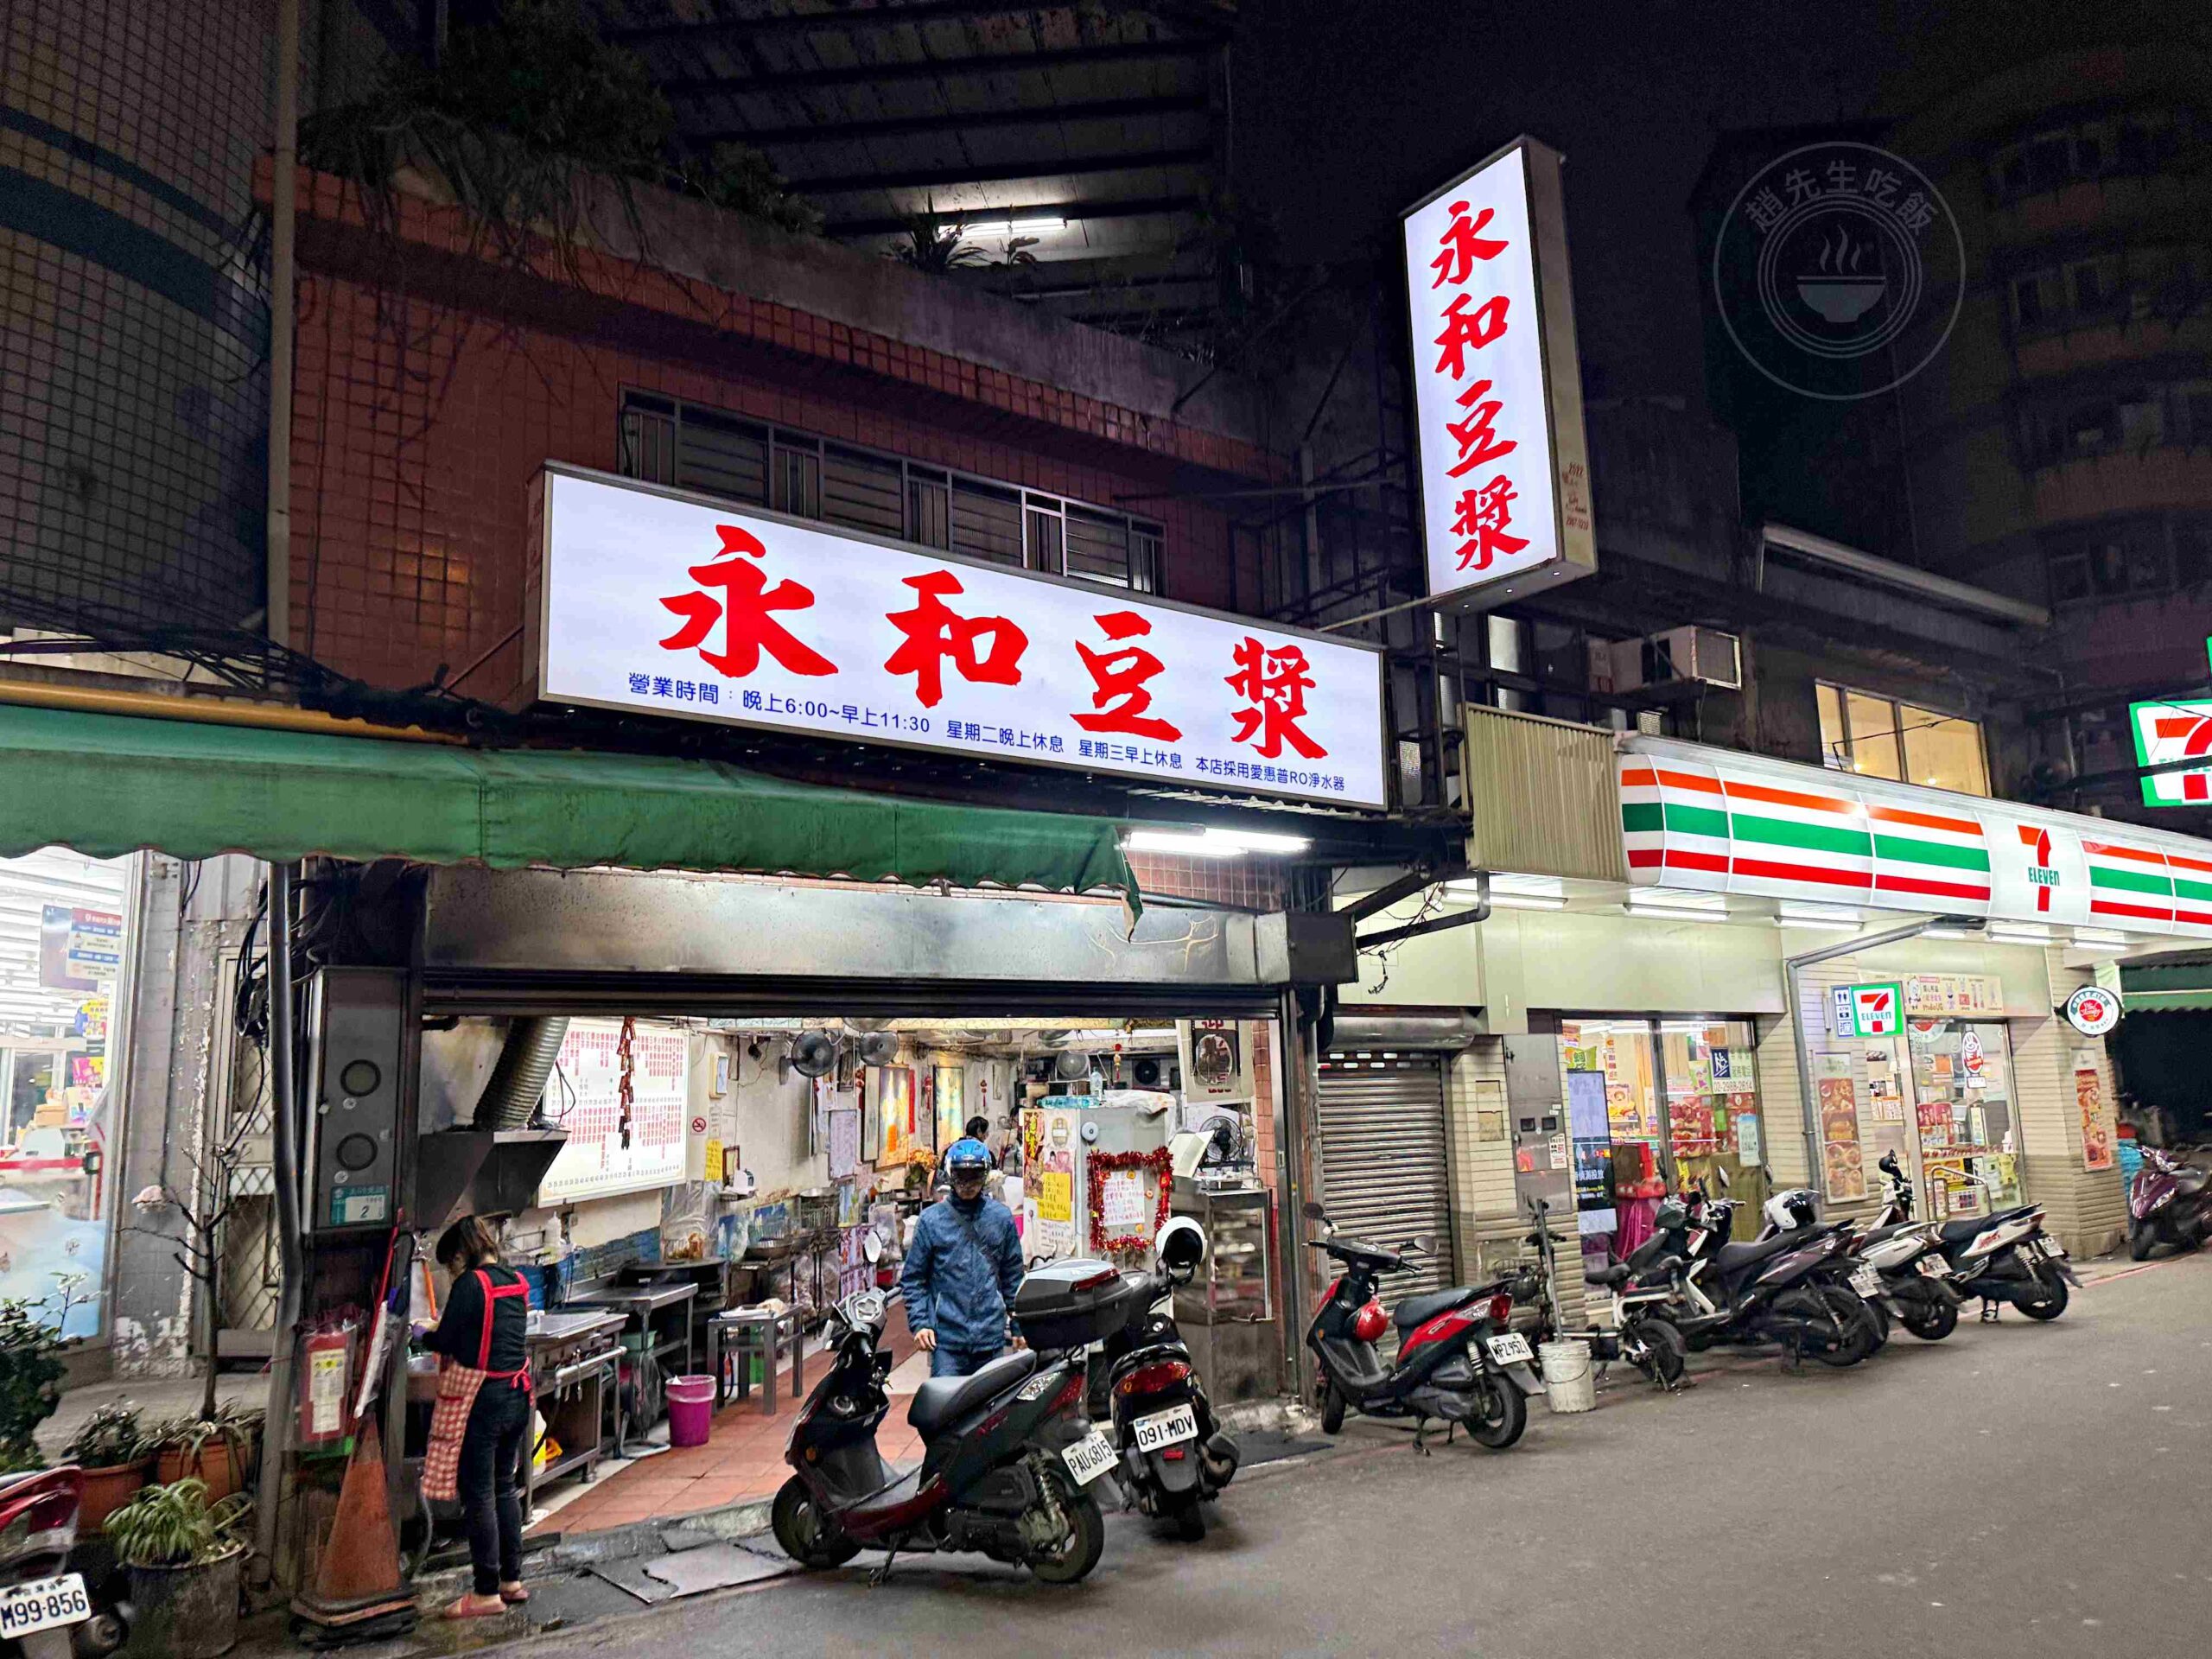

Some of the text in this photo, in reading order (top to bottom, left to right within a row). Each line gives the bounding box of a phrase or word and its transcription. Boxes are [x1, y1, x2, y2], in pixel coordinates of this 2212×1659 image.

[1431, 200, 1530, 571] 永和豆漿
[659, 524, 1328, 759] 永和豆漿
[946, 719, 1065, 753] 星期二晚上休息
[1078, 738, 1183, 770] 星期三早上休息
[1196, 756, 1345, 791] 本店採用愛惠普RO淨水器
[1138, 1414, 1193, 1446] 091-MDV
[1067, 1440, 1113, 1477] PAU-6815
